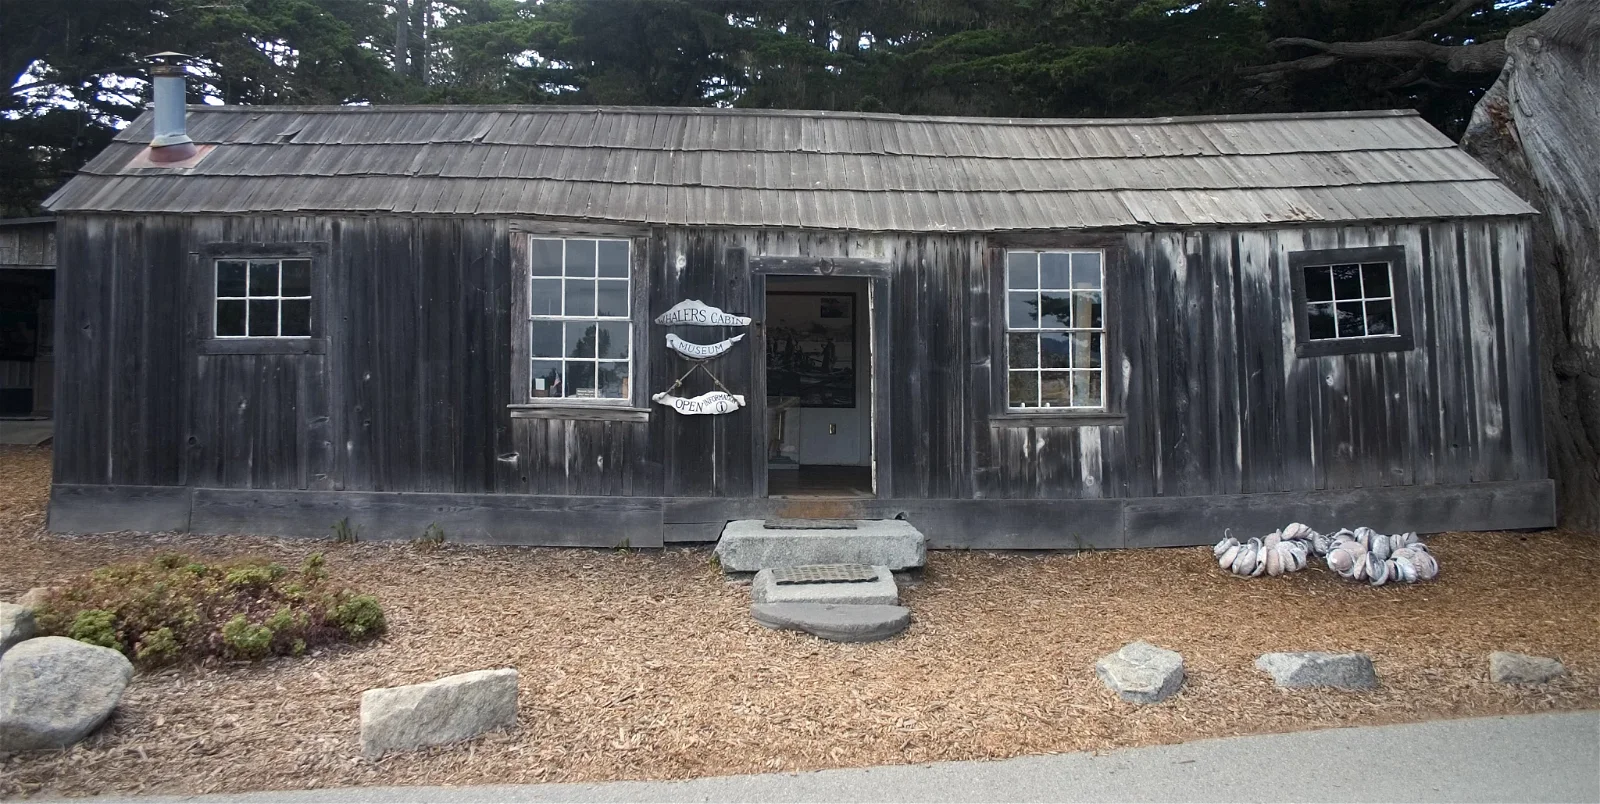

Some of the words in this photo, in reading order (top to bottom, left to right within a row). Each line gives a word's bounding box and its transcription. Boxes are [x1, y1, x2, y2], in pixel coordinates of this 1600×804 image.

[657, 308, 706, 324] WHALERS
[710, 312, 744, 324] CABIN
[678, 342, 724, 354] MUSEUM
[675, 399, 704, 412] OPEN
